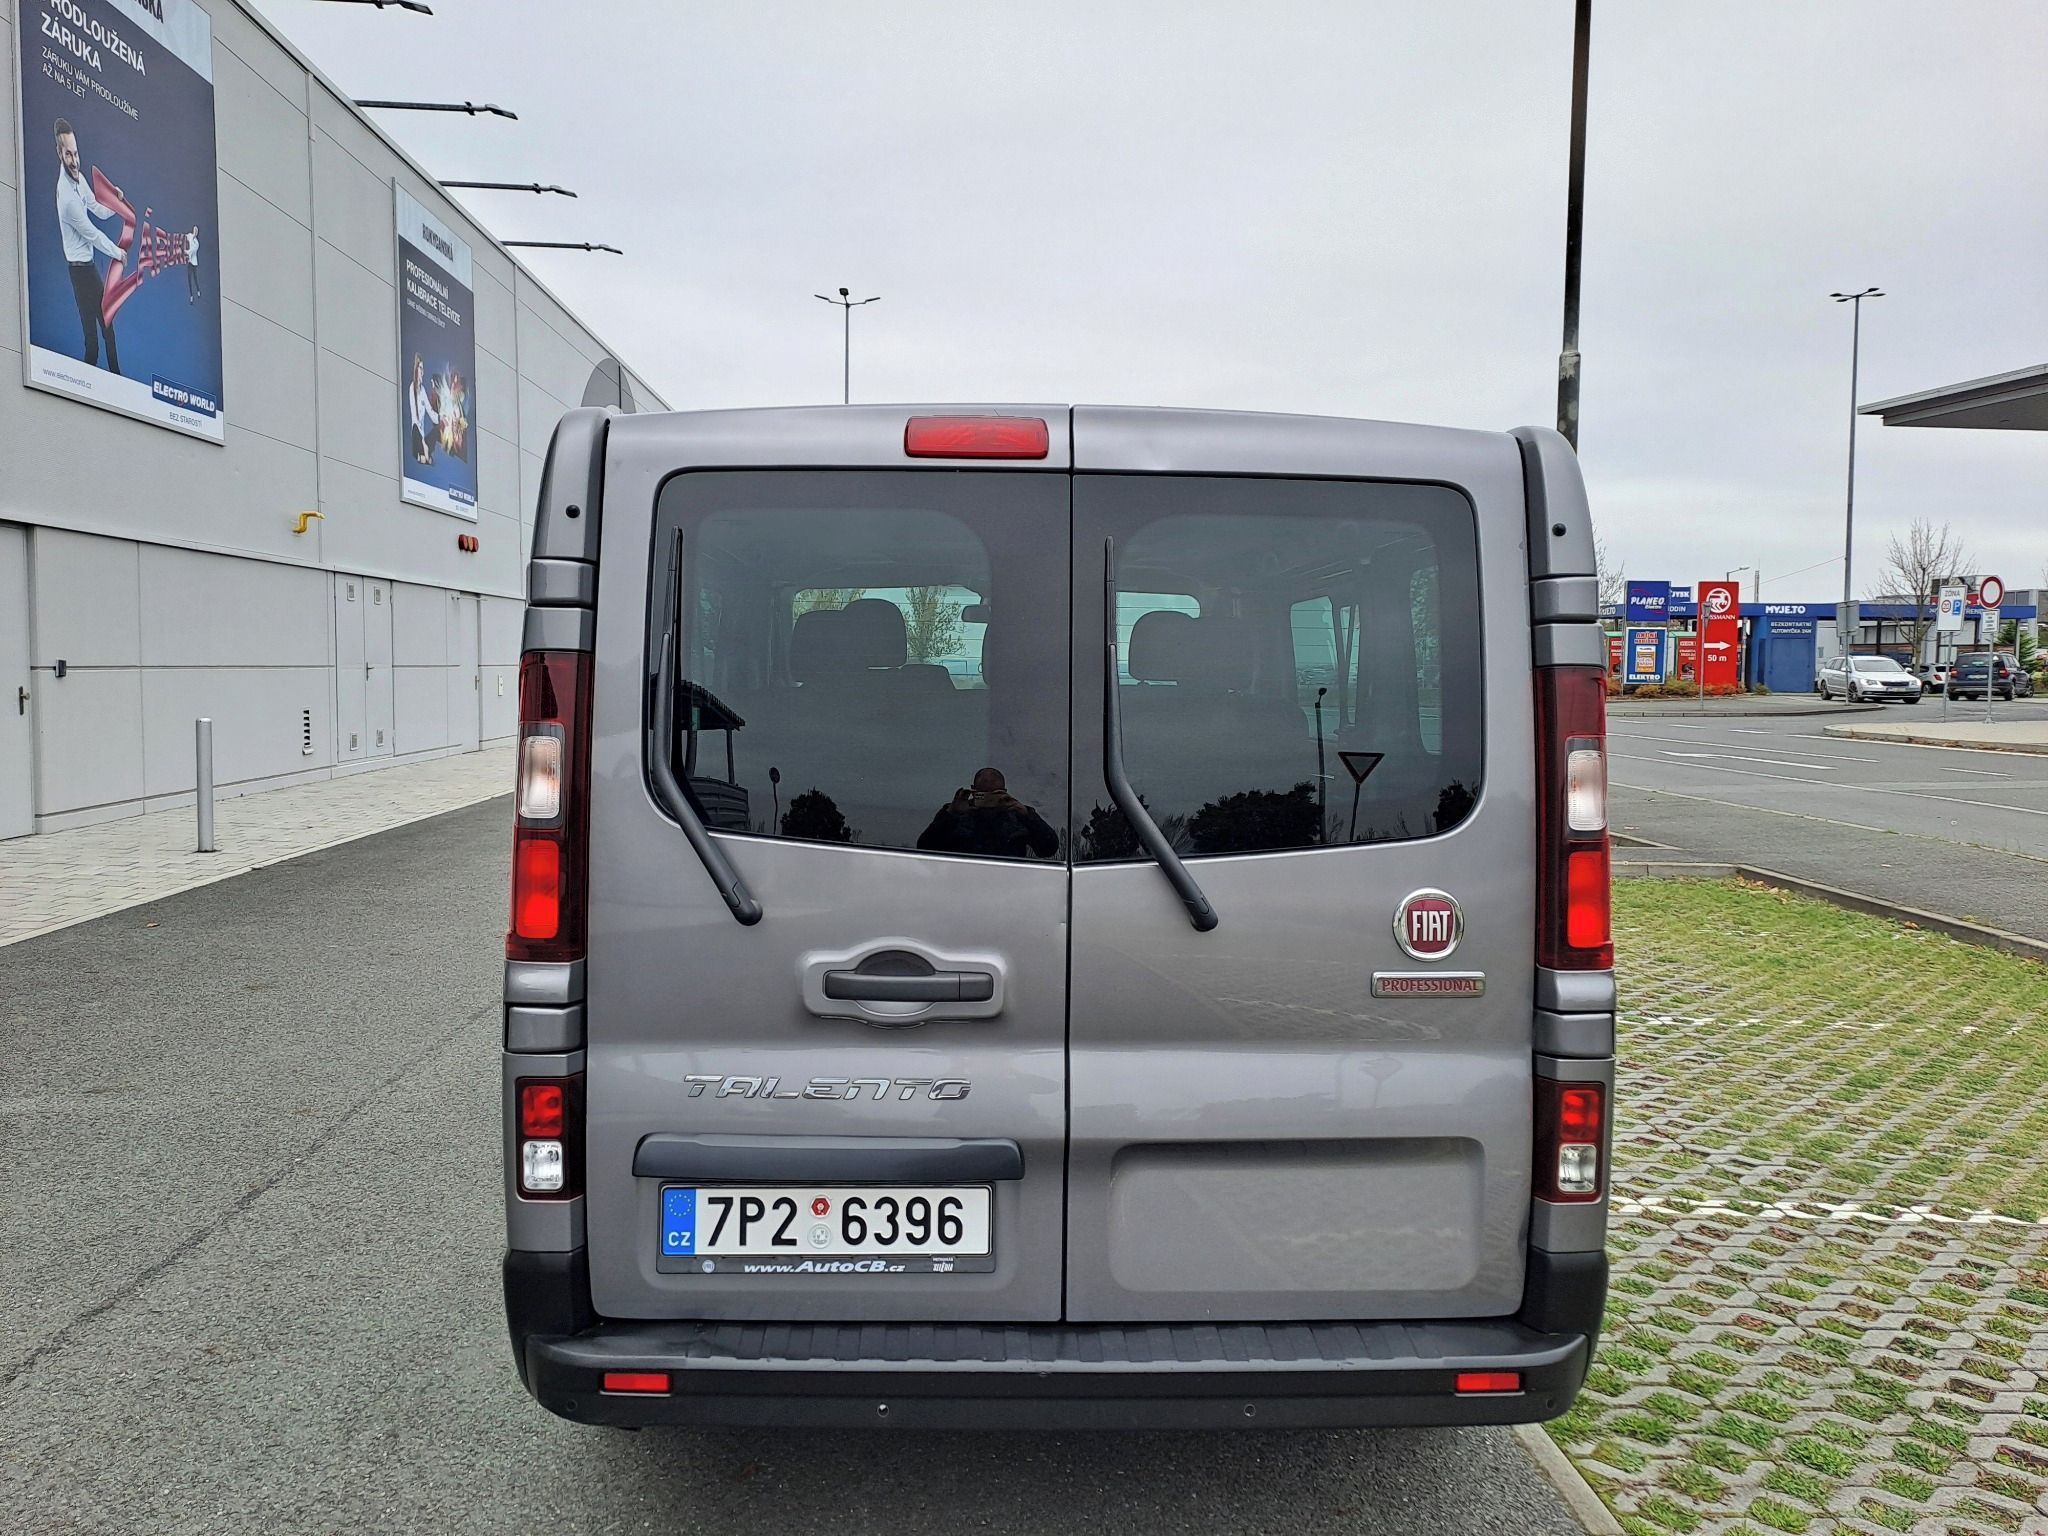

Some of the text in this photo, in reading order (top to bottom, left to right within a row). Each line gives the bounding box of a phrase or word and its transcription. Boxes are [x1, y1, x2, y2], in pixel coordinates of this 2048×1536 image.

[41, 12, 102, 73] ZÁRUKA
[42, 63, 86, 99] AŽ NA 5 LET
[42, 46, 139, 121] ZÁRUKU VÁM PRODLOUŽÍME
[406, 278, 438, 310] KALIBRACE
[438, 300, 461, 326] TELEVIZE
[153, 381, 215, 412] ELECTRO WORLD
[1630, 596, 1665, 605] PLANEO
[1412, 910, 1450, 942] FIAT
[1381, 979, 1480, 992] PROFESSIONAL
[684, 1074, 972, 1101] TALENTO
[707, 1196, 964, 1247] 7P2 6396
[668, 1232, 691, 1247] CZ
[743, 1260, 906, 1274] www.AutoCB.cz
